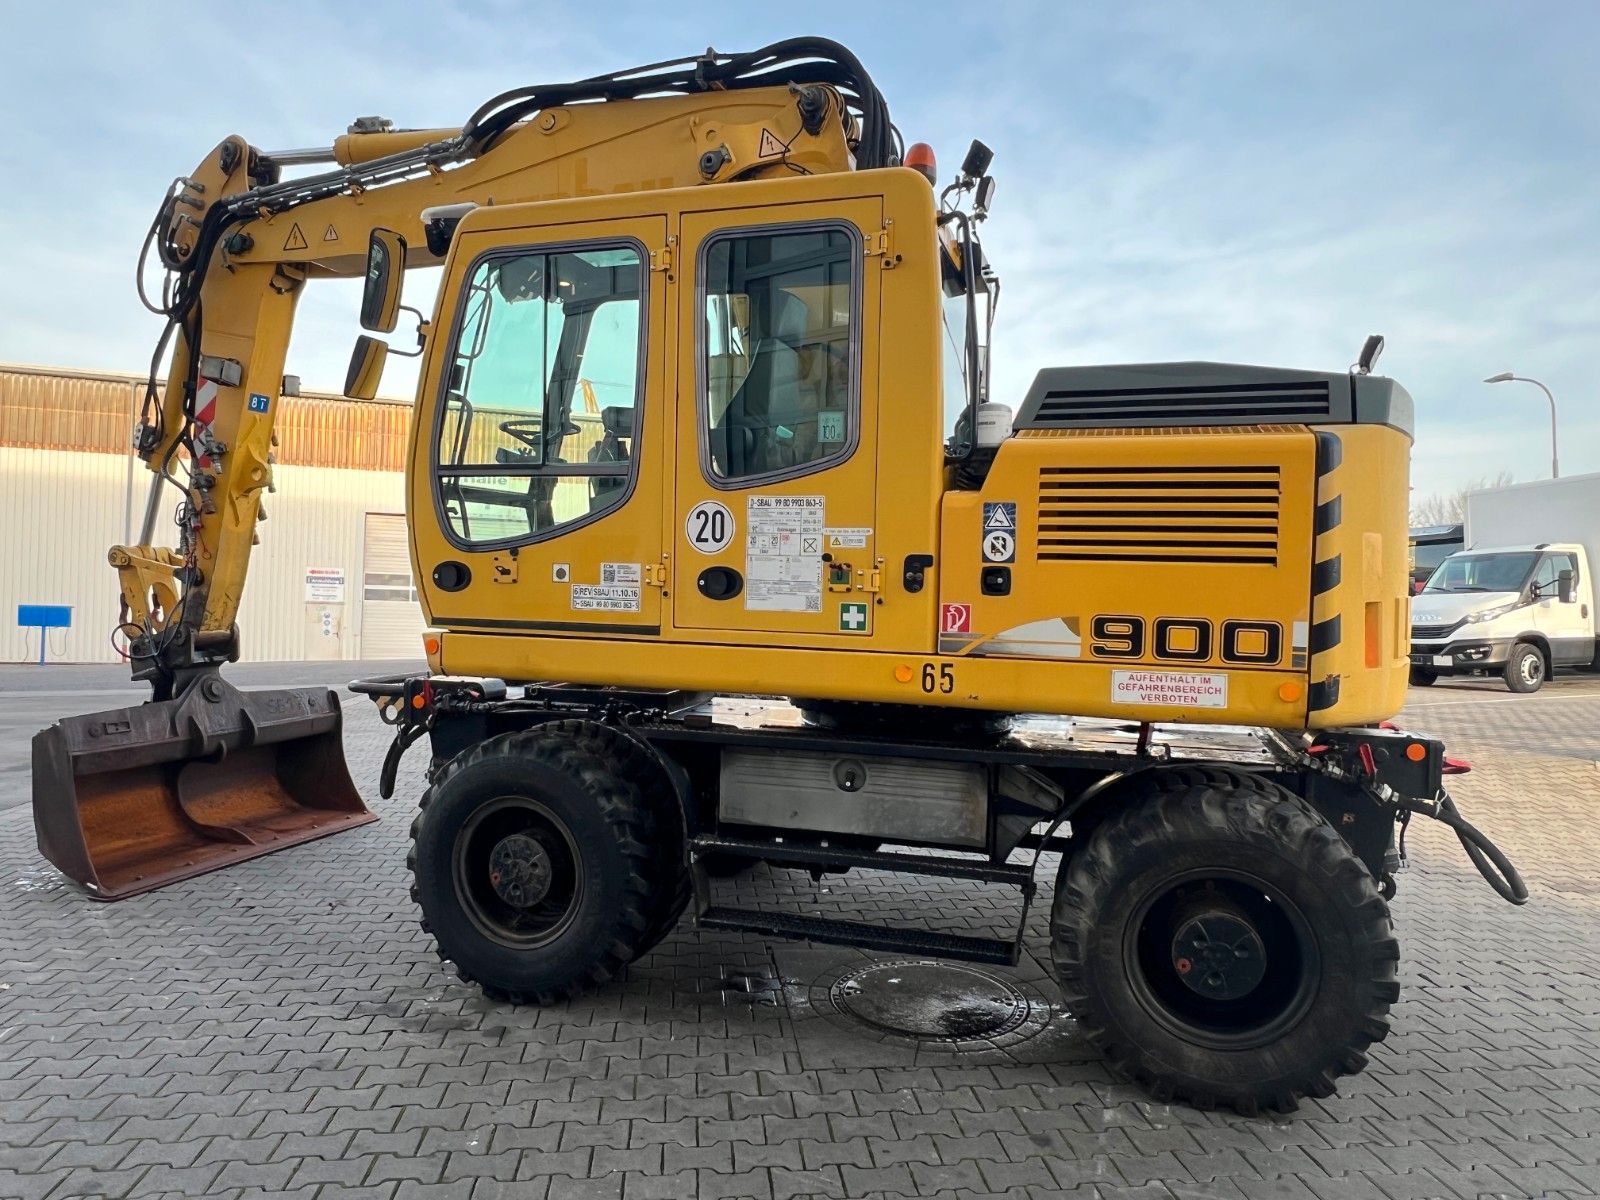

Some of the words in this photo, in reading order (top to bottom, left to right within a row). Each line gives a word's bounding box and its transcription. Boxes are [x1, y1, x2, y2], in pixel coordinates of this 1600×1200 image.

[774, 498, 782, 508] 99
[695, 509, 725, 544] 20
[579, 588, 592, 596] REV
[611, 589, 639, 598] 11.10.16
[1090, 614, 1284, 666] 900
[922, 662, 954, 694] 65
[1128, 673, 1197, 684] AUFENTHALT
[1200, 676, 1212, 685] IM
[1117, 682, 1222, 695] GEFAHRENBEREICH
[1140, 693, 1198, 704] VERBOTEN
